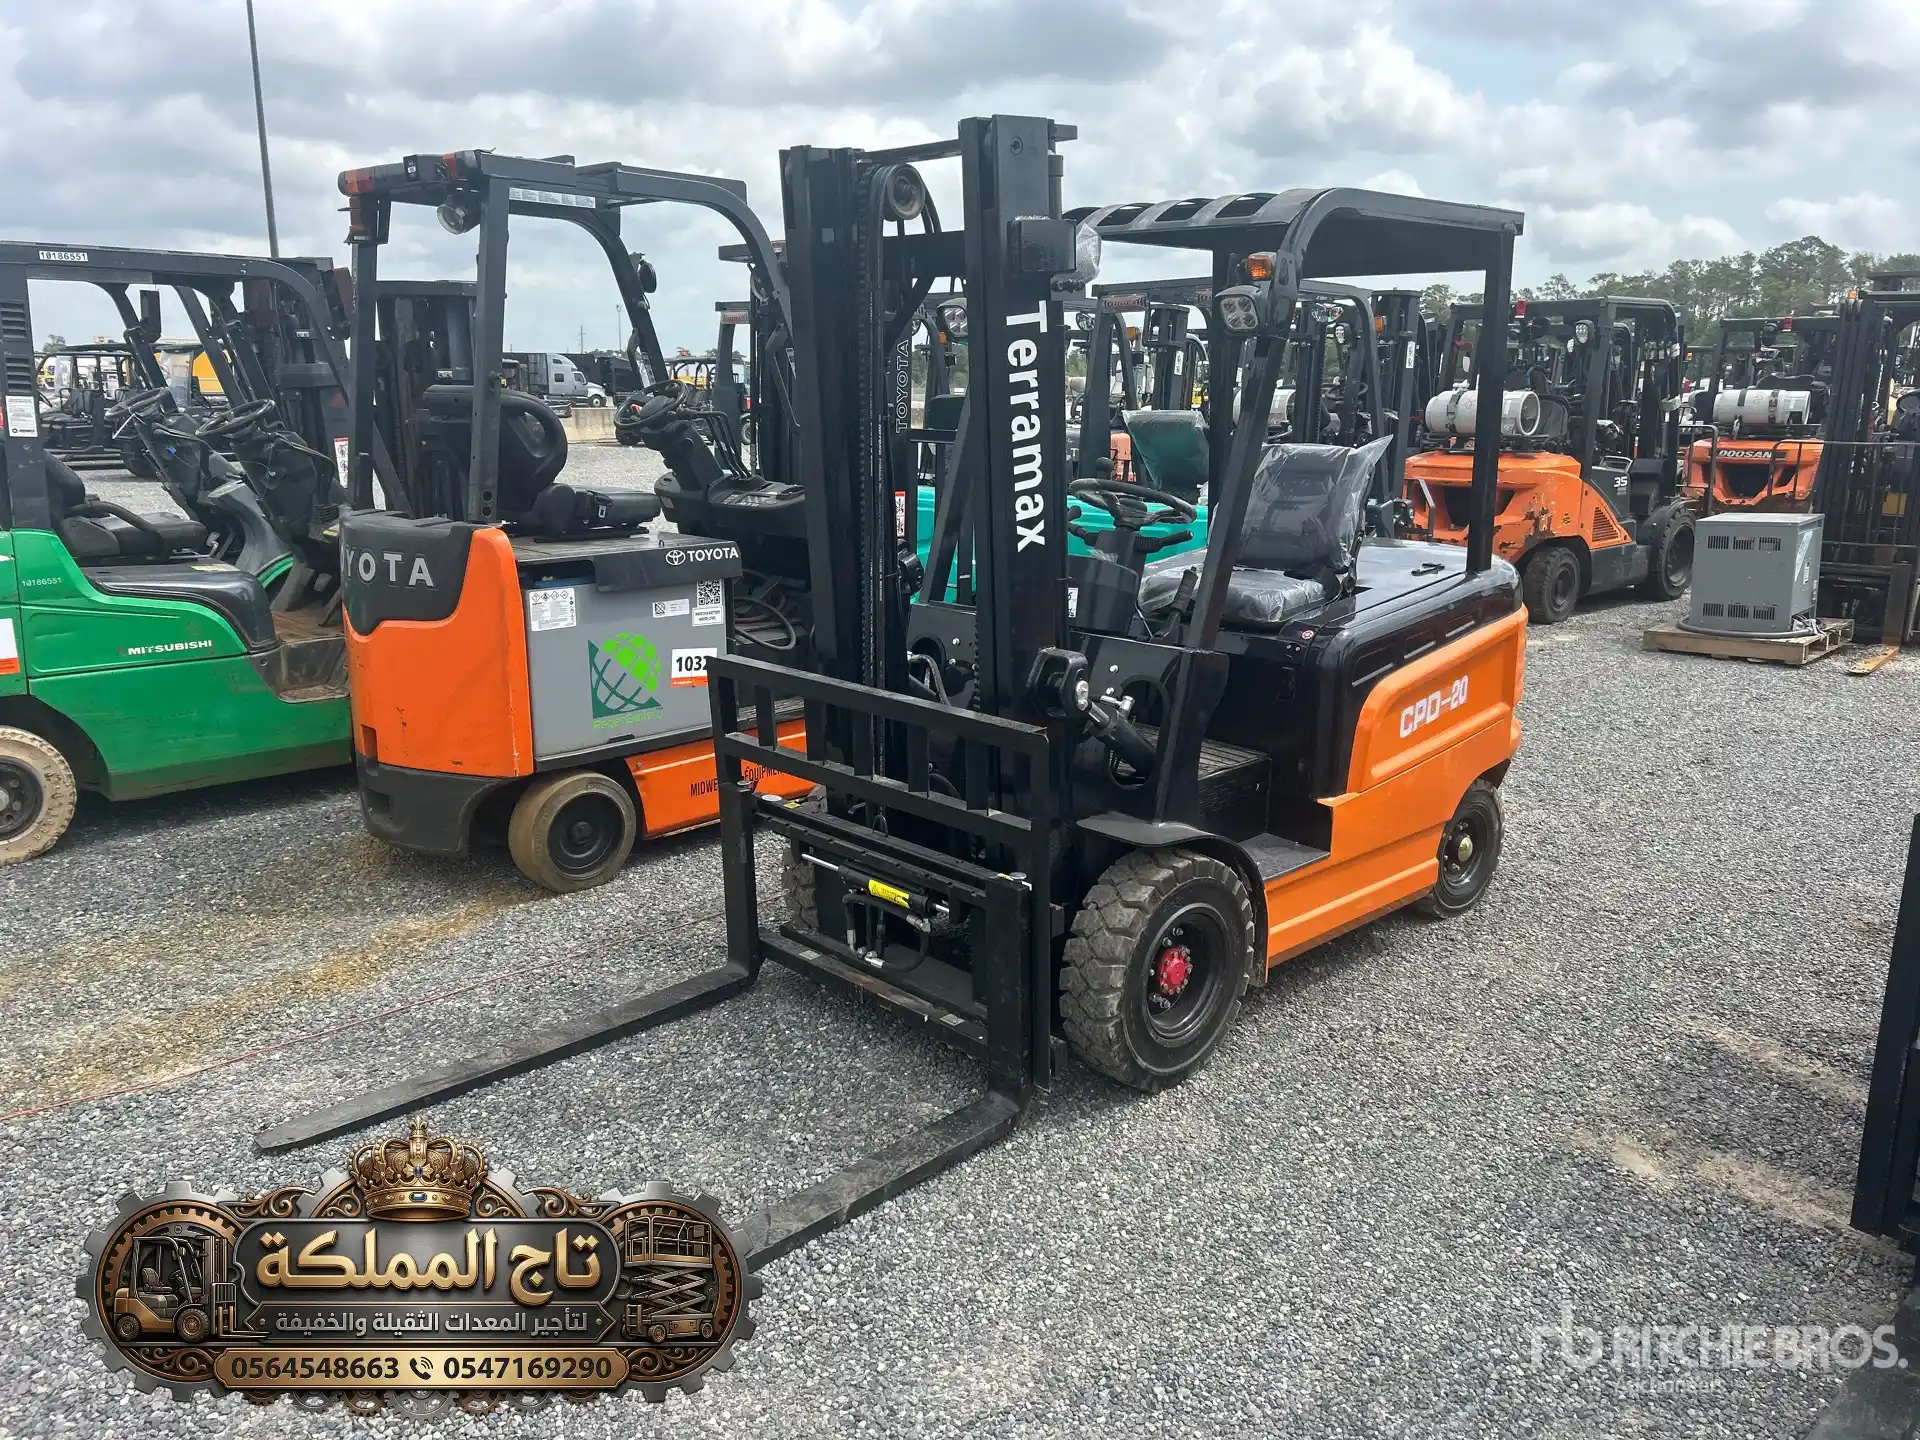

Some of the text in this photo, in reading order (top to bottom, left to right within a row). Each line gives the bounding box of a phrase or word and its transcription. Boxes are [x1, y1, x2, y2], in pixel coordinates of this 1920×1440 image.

[40, 251, 87, 261] 10186551
[896, 340, 909, 433] TOYOTA
[1006, 300, 1048, 553] Terramax
[1718, 450, 1773, 458] DOOSAN
[1613, 476, 1628, 488] 35
[686, 547, 739, 561] TOYOTA
[22, 577, 62, 587] 10186551
[128, 640, 212, 655] MITSUBISHI
[1400, 675, 1468, 738] CPD-20
